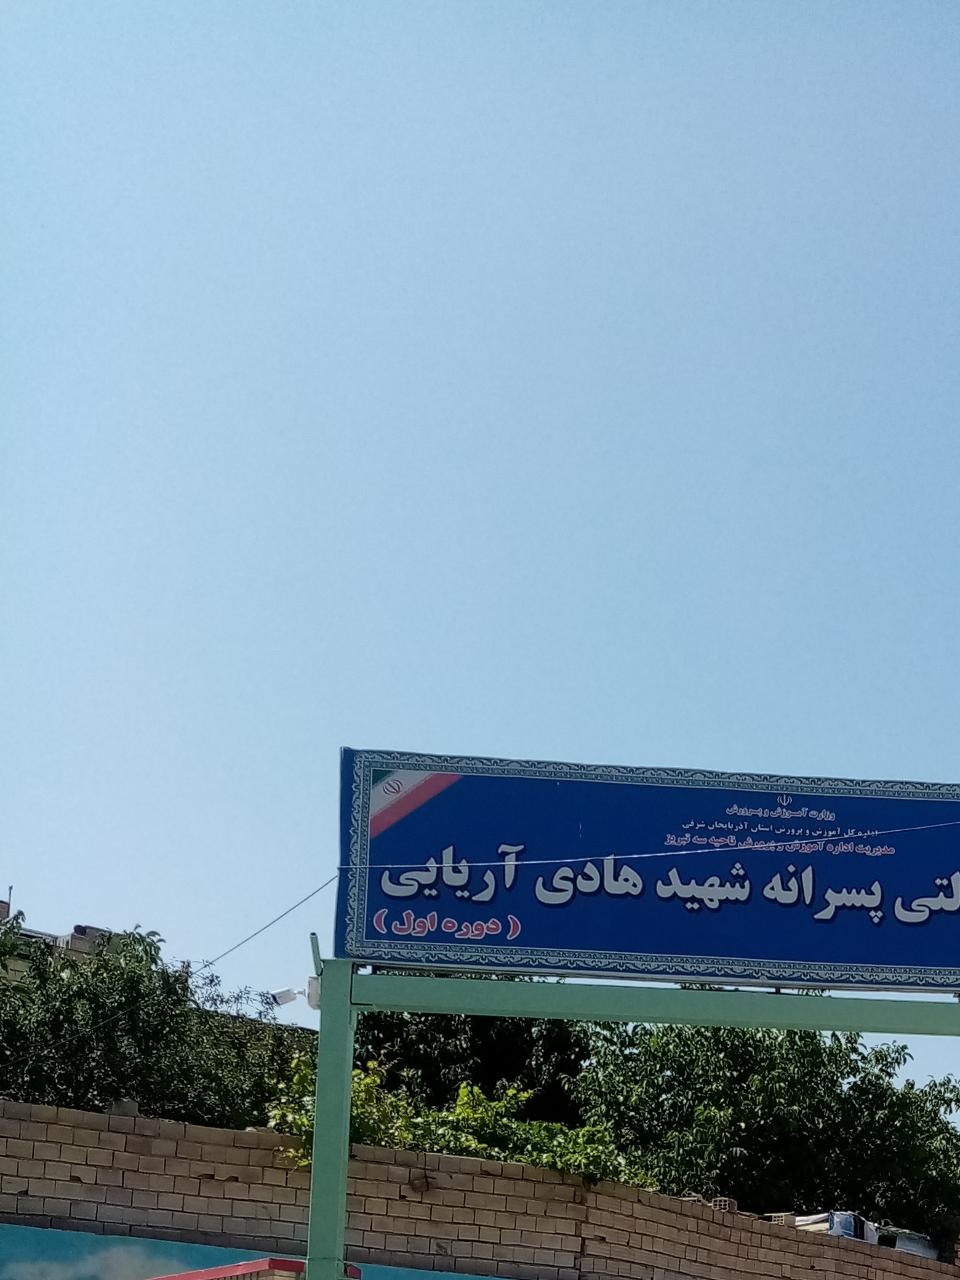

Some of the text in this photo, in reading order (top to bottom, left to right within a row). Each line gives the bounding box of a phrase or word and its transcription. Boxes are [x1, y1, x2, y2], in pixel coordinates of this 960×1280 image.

[381, 845, 524, 901] آریایی
[535, 854, 643, 904] هادی
[656, 862, 750, 909] شهید
[763, 864, 884, 924] پسرانه
